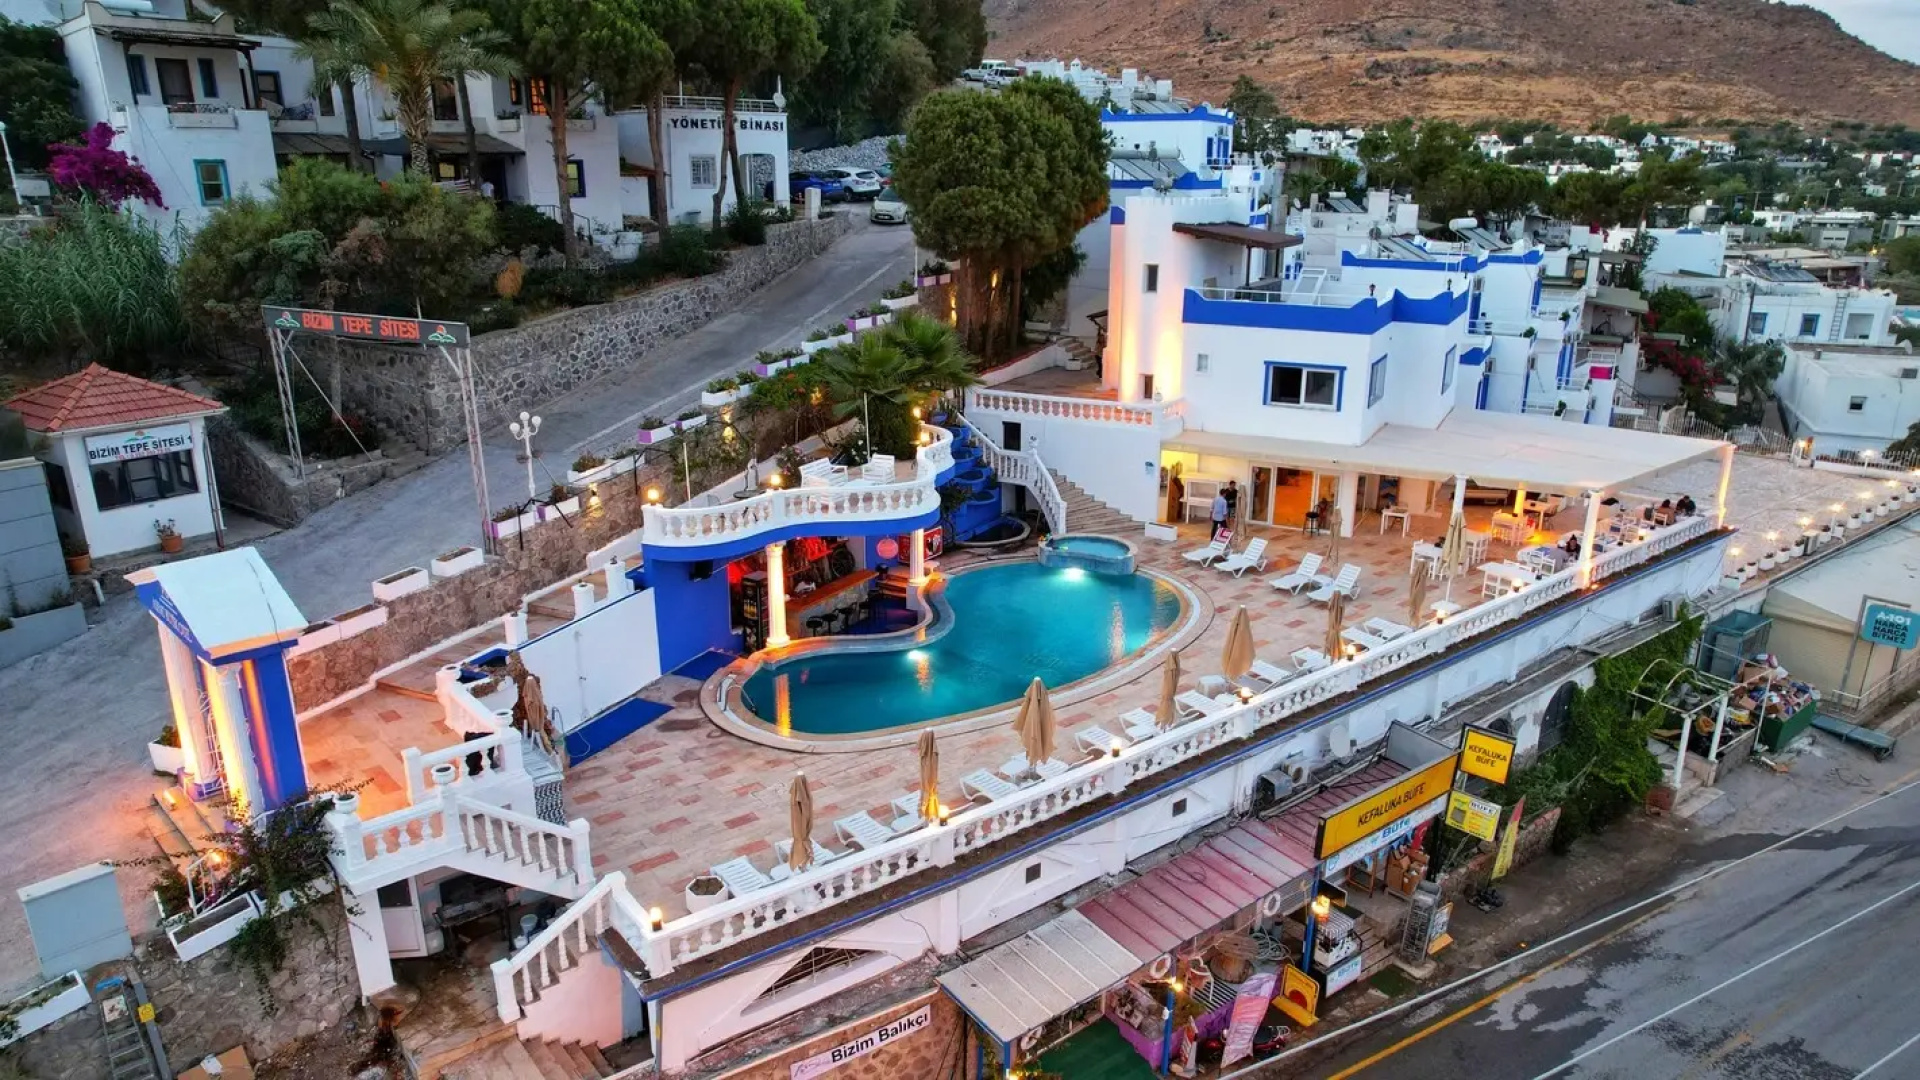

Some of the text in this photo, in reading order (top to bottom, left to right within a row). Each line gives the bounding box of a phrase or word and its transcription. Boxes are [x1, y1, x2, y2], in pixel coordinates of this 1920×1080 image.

[671, 115, 784, 132] YÖNETİ BİNASI
[342, 316, 374, 335] TEPE
[89, 445, 120, 460] BİZİM
[122, 442, 150, 454] TEPE
[152, 434, 185, 449] SİTESİ
[1875, 618, 1909, 632] HARCA
[1468, 744, 1508, 762] KEFALUKA
[1358, 795, 1402, 827] KEFALUKA
[831, 1013, 928, 1063] Bizim Balıkçı
